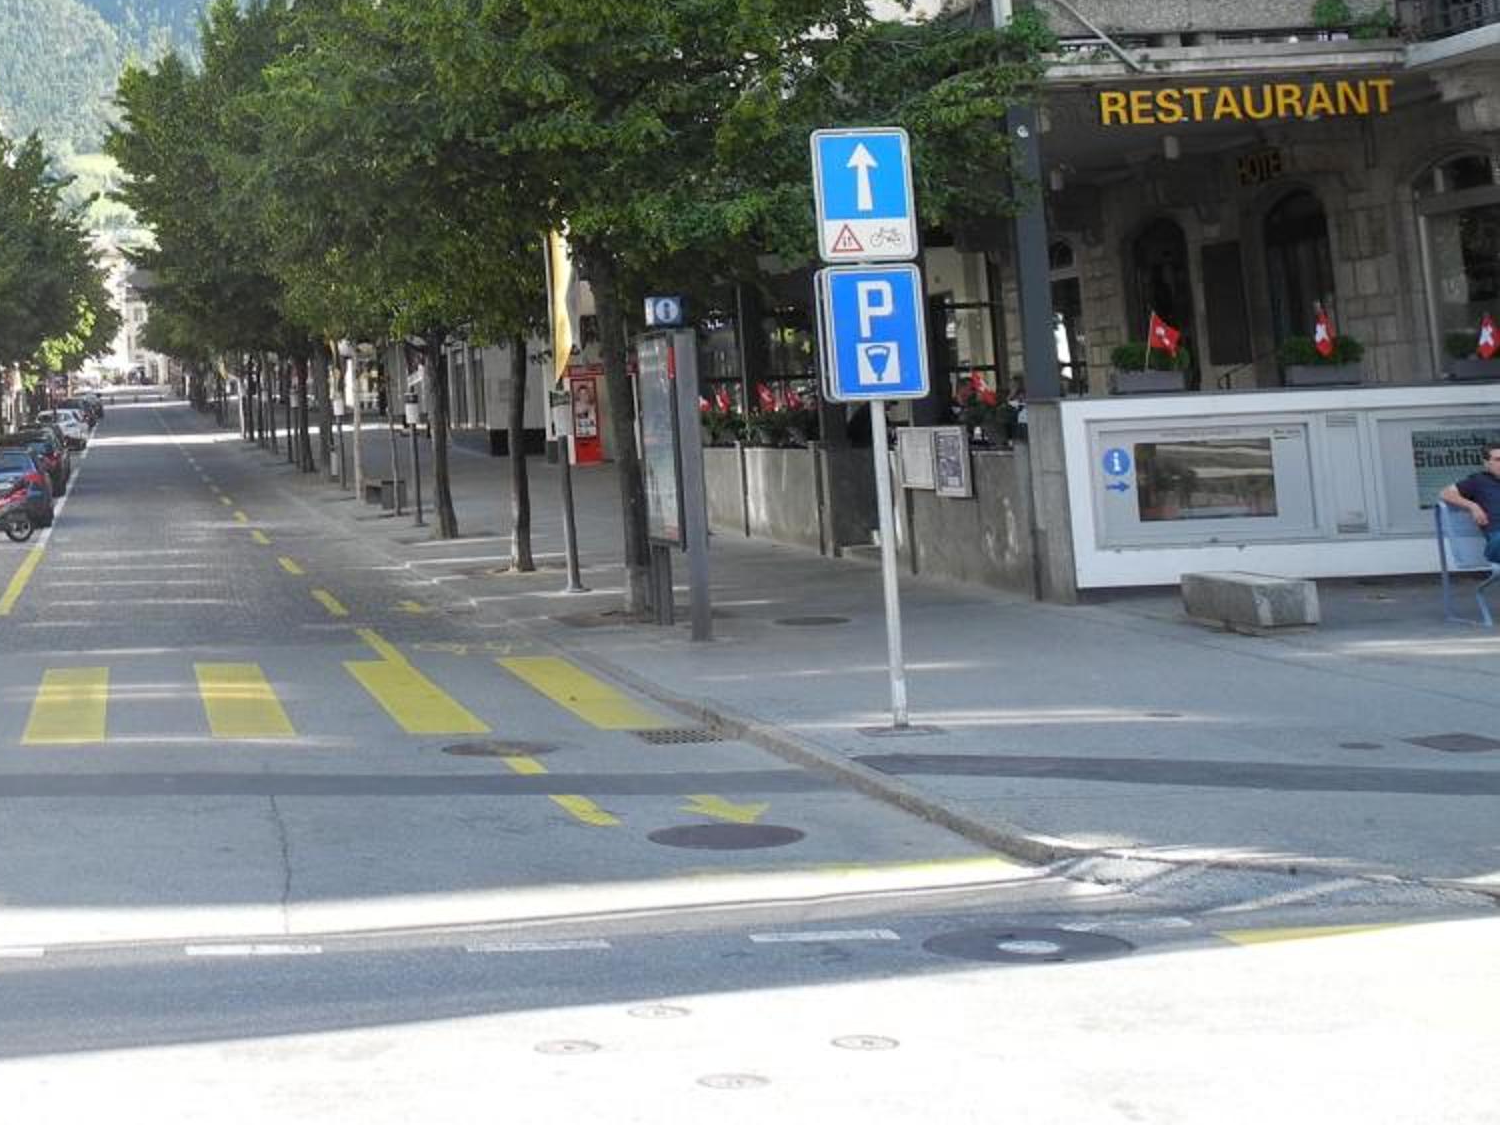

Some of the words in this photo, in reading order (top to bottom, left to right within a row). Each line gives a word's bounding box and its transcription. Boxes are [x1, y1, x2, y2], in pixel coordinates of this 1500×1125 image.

[1100, 79, 1394, 125] RESTAURANT
[857, 280, 894, 338] P
[1413, 448, 1482, 468] Stadtfü
